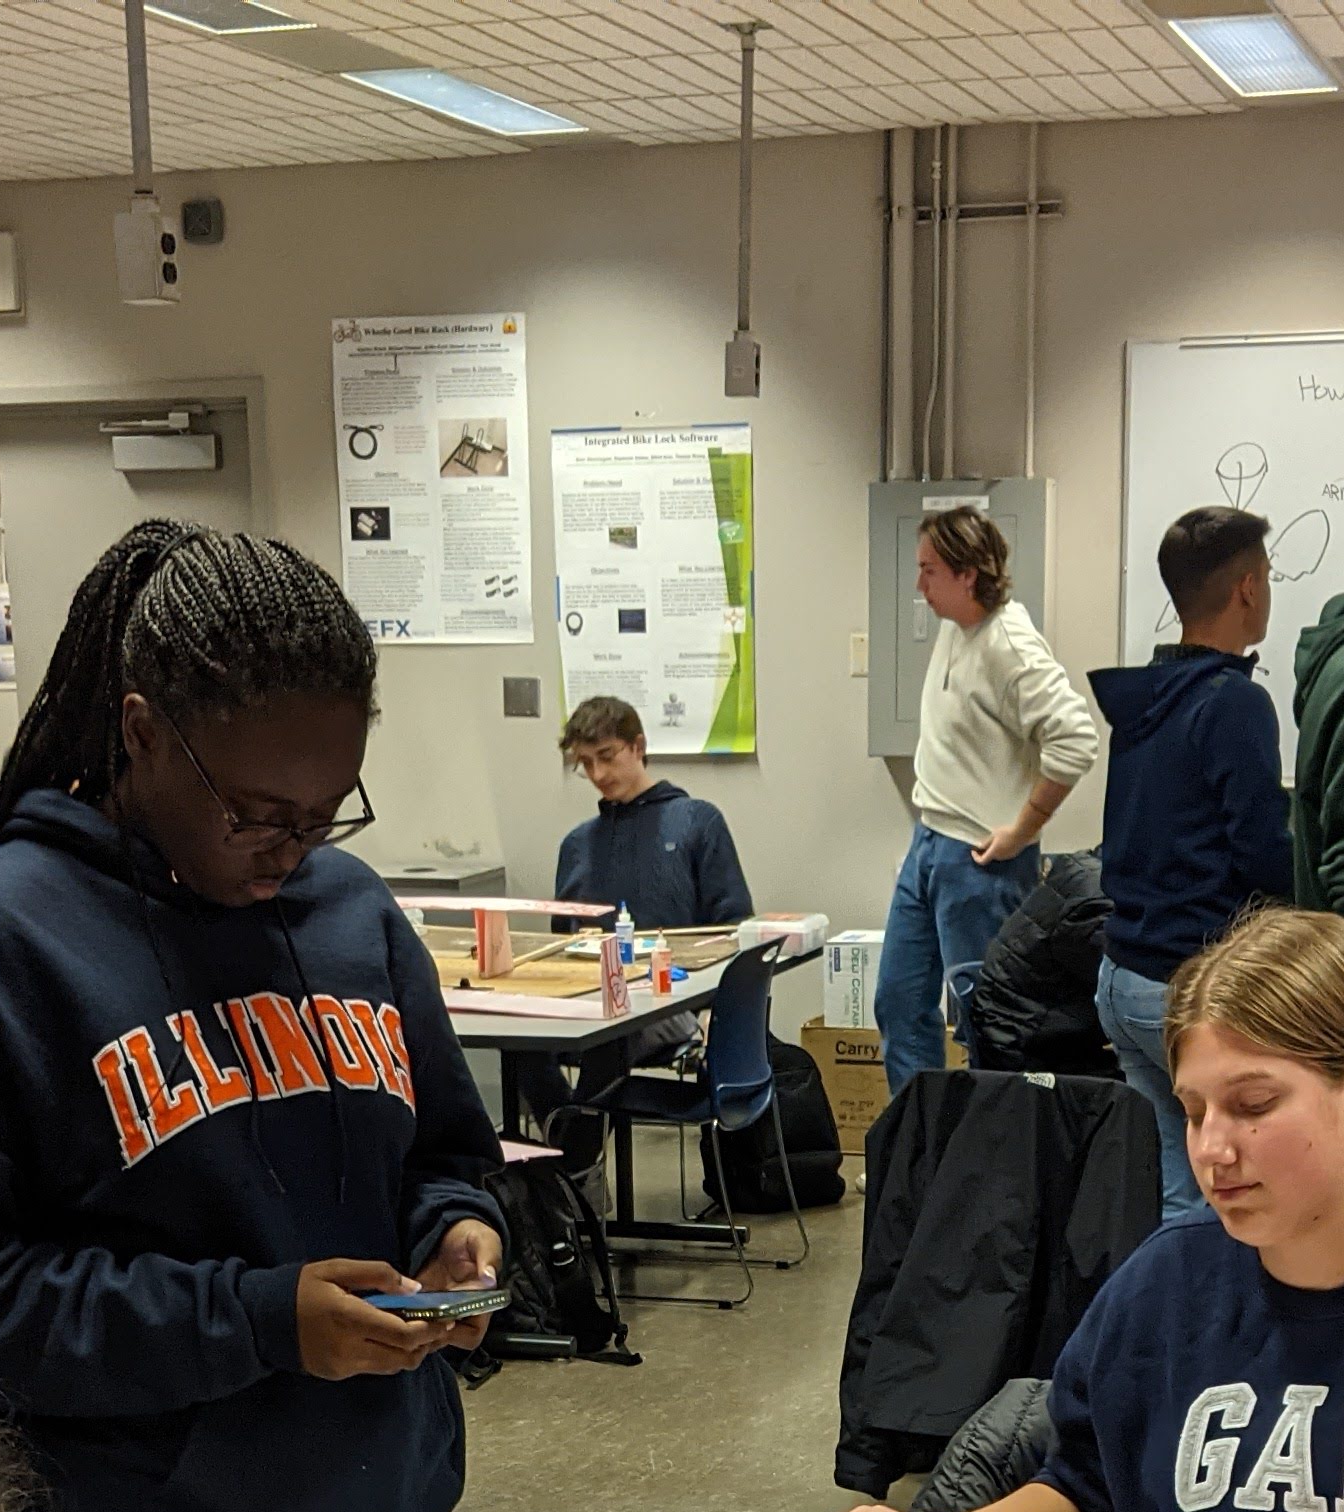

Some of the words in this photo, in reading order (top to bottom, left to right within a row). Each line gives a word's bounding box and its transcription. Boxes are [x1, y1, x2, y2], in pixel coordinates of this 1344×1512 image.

[393, 325, 413, 336] Good
[414, 325, 430, 335] Bike
[583, 435, 630, 448] Integrated
[632, 434, 652, 445] Bike
[654, 433, 677, 444] Lock
[678, 432, 719, 444] Software
[834, 1040, 880, 1059] Carry
